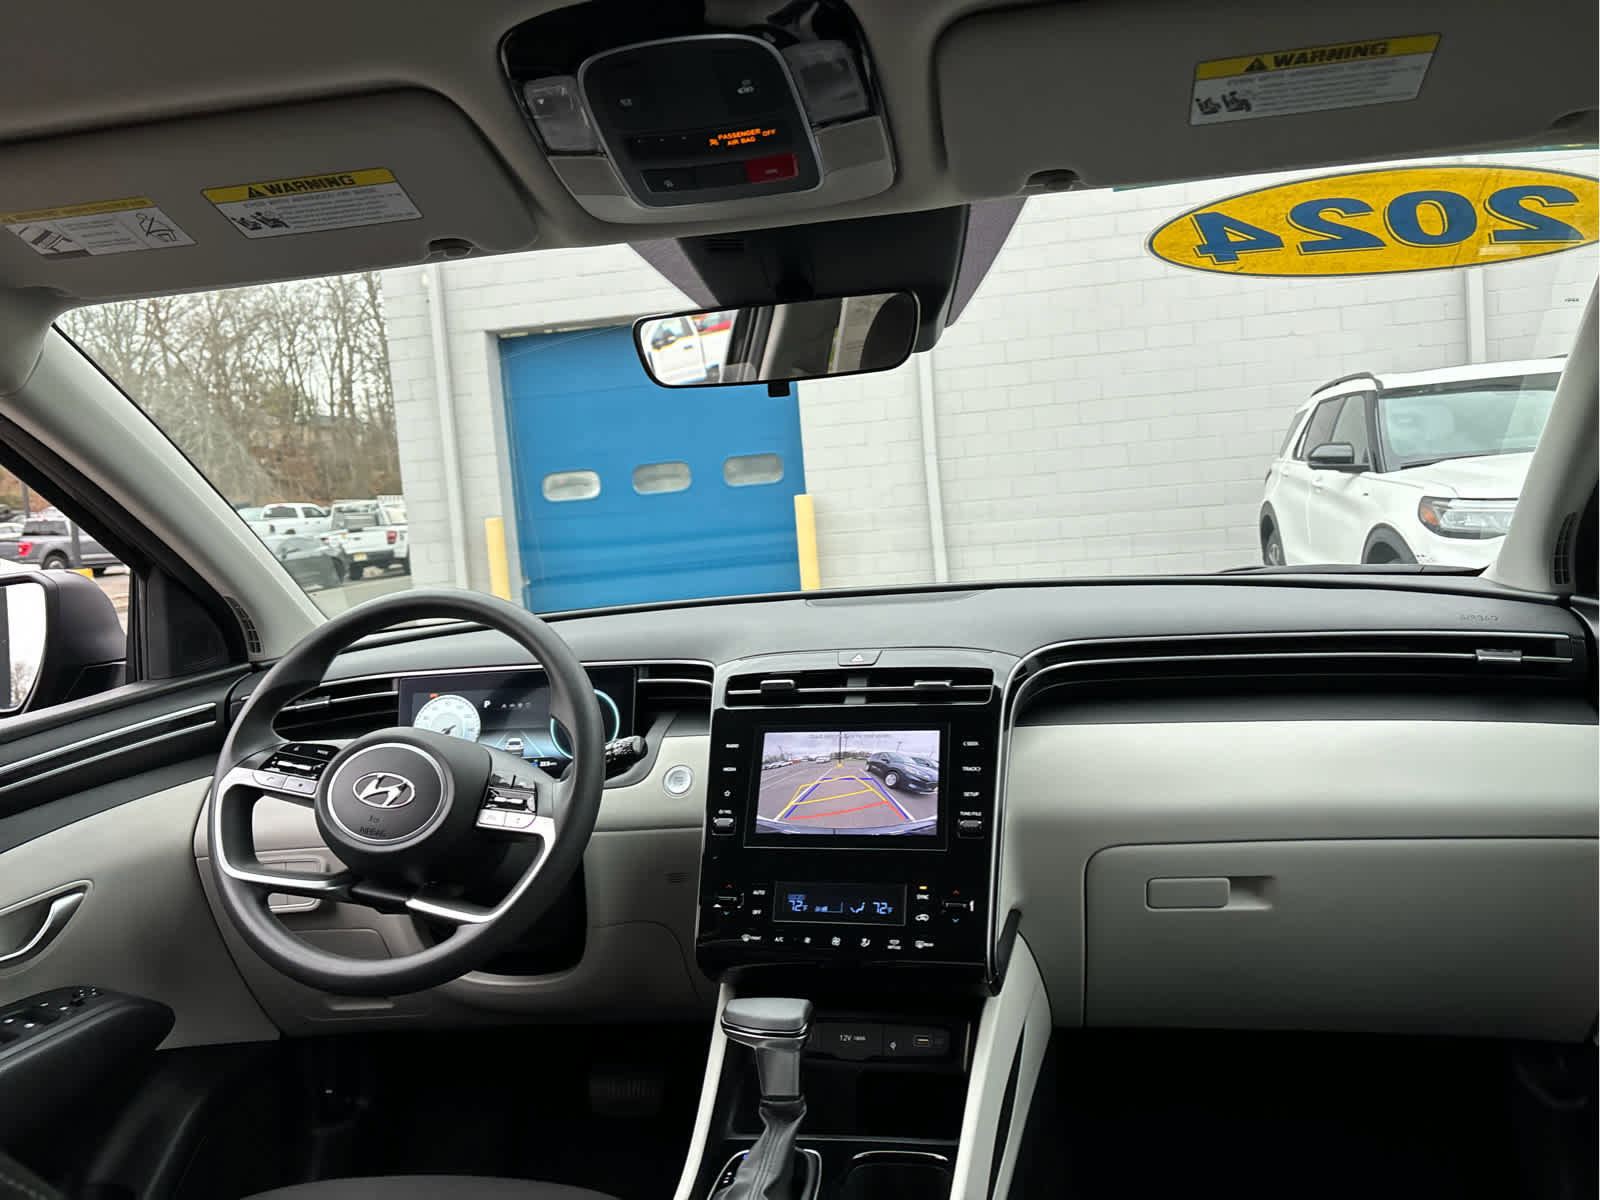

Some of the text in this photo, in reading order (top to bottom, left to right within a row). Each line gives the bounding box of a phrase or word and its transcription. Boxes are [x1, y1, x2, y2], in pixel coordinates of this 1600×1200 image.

[1273, 41, 1388, 68] WARNING
[717, 128, 777, 140] PASSENGER OFF
[728, 136, 756, 146] AIR BAG
[265, 174, 356, 196] WARNING
